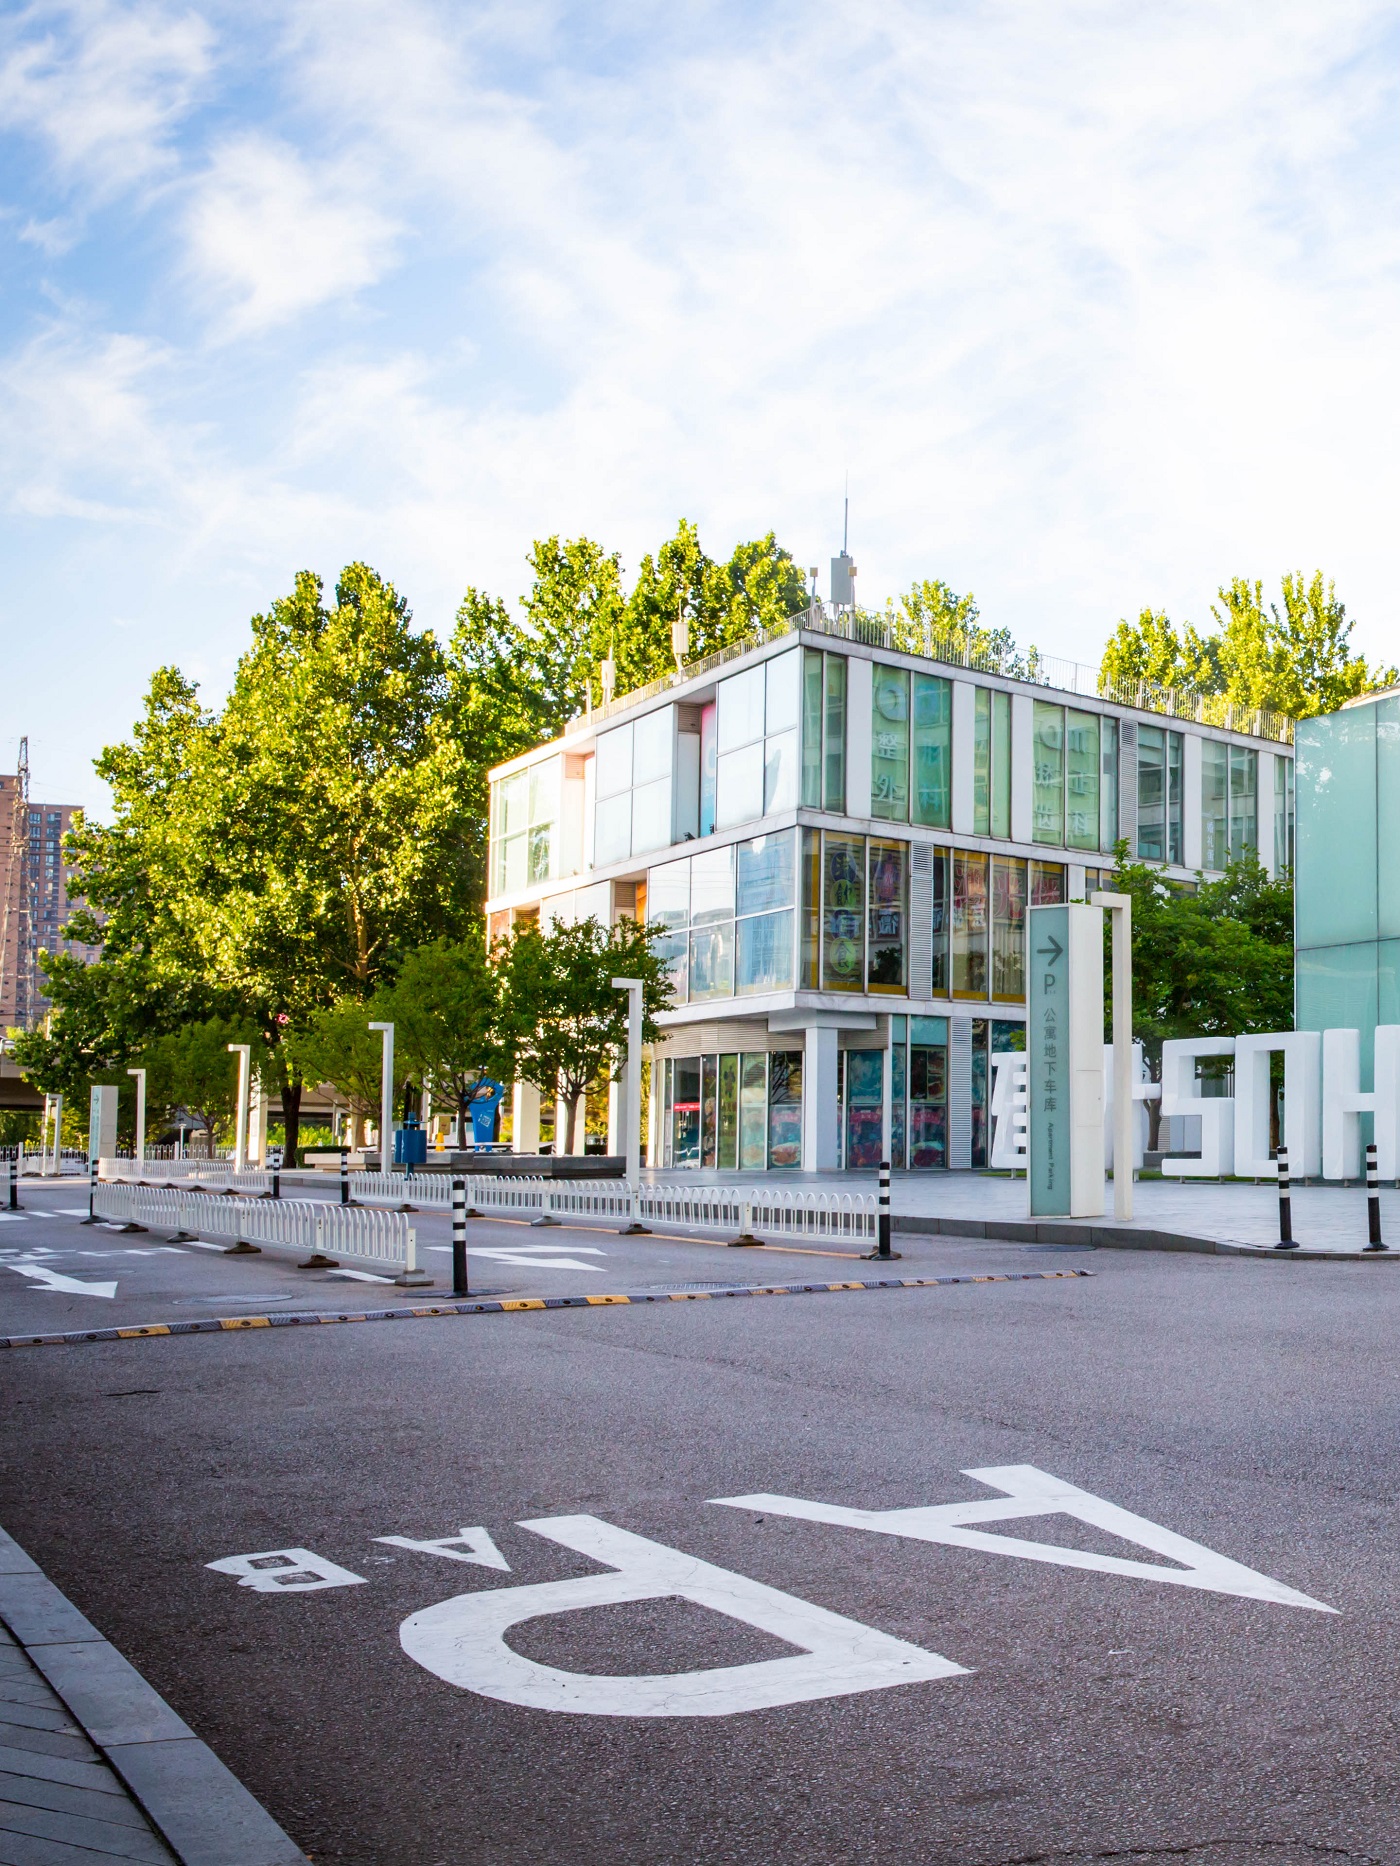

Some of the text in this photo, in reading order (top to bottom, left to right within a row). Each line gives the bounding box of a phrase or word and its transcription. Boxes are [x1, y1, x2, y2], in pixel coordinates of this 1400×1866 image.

[1044, 973, 1057, 995] P
[1043, 1007, 1057, 1113] 公寓地下车库
